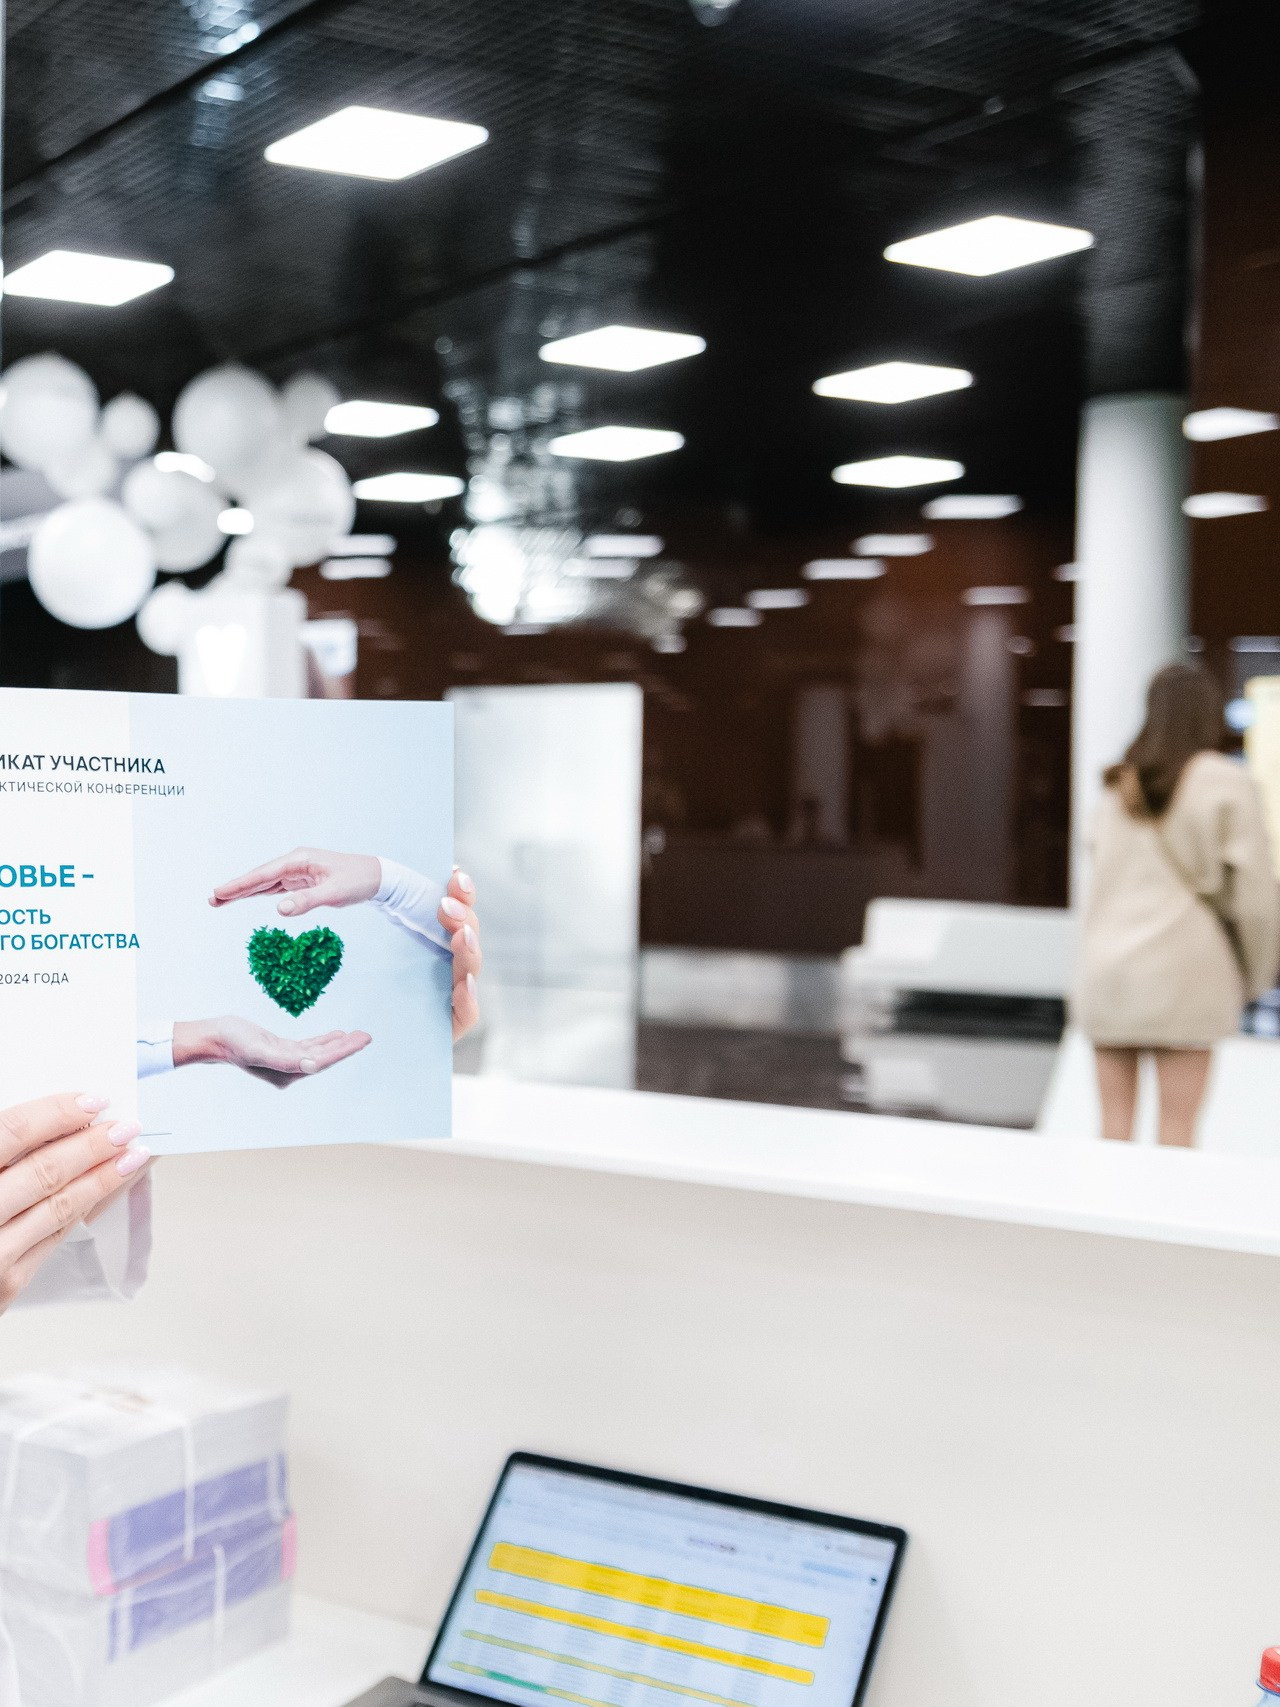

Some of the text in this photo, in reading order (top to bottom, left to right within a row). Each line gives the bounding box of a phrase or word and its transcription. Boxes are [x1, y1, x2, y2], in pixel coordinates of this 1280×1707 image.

[49, 755, 166, 774] УЧАСТНИКА
[87, 782, 185, 797] КОНФЕРЕНЦИИ
[30, 933, 141, 951] БОГАТСТВА
[34, 972, 69, 986] ГОДА
